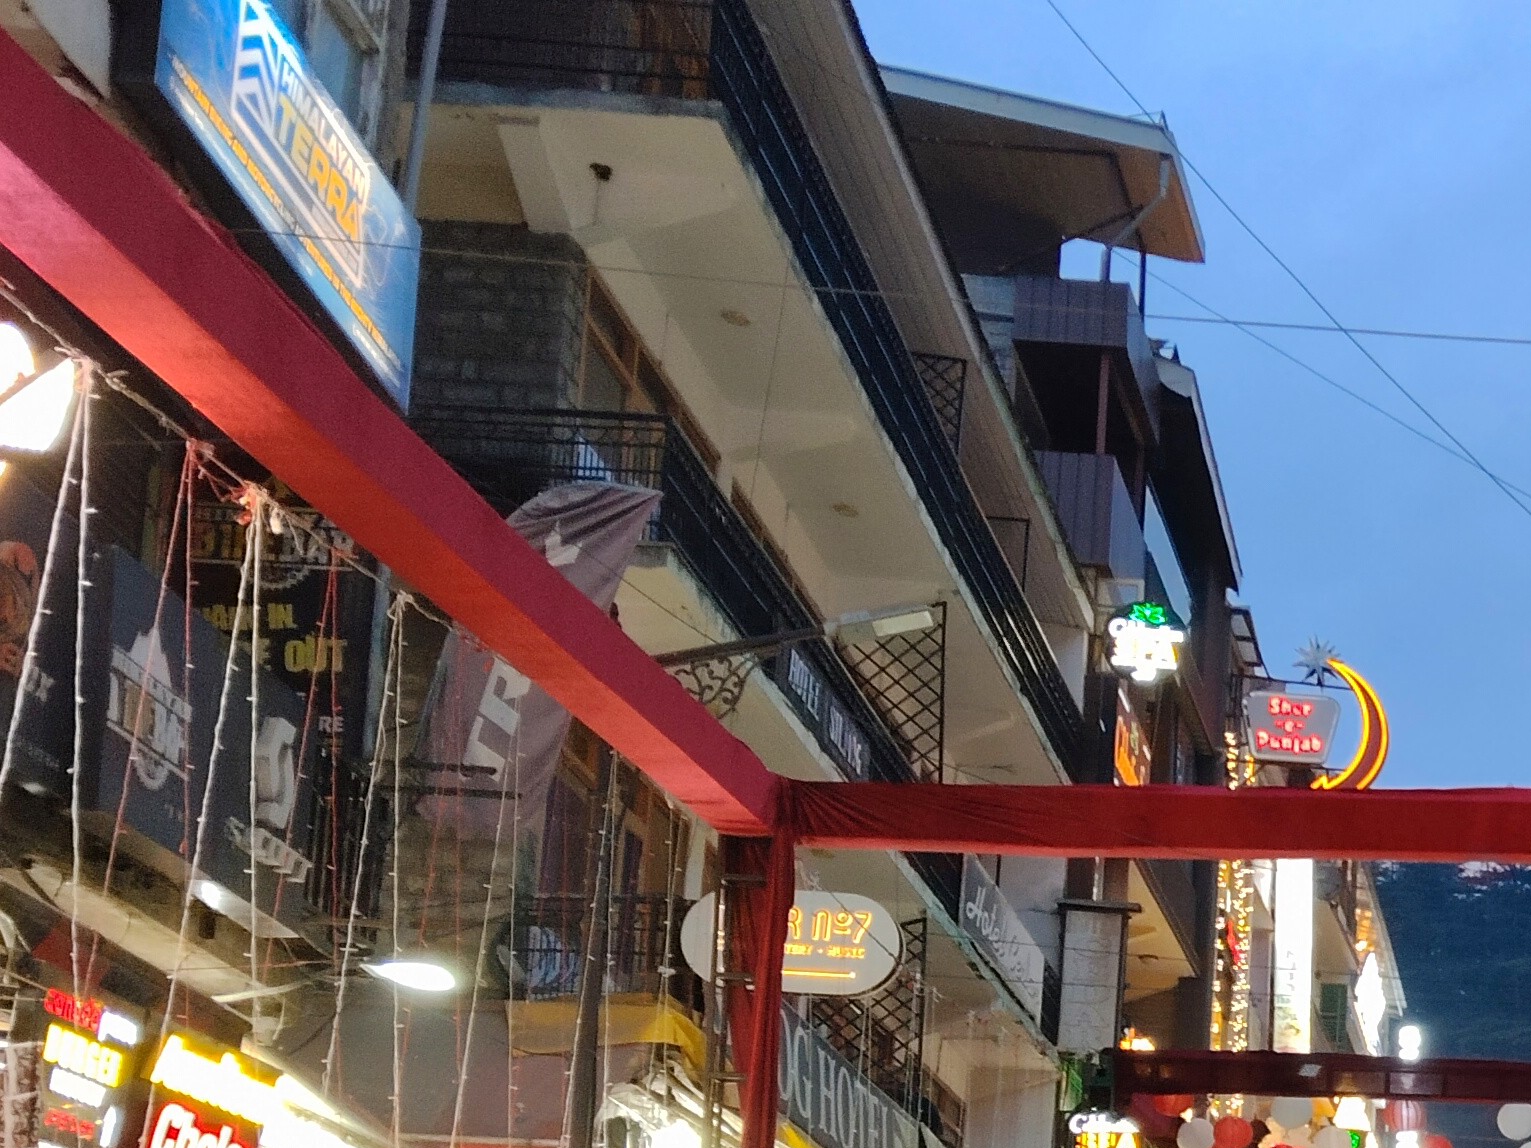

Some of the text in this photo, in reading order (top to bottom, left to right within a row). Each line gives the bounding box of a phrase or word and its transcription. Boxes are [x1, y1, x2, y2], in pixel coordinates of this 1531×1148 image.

[278, 93, 362, 243] TERRA
[282, 62, 366, 205] HIMALAYAN
[1255, 730, 1324, 754] Punjab
[1268, 696, 1314, 718] Sher
